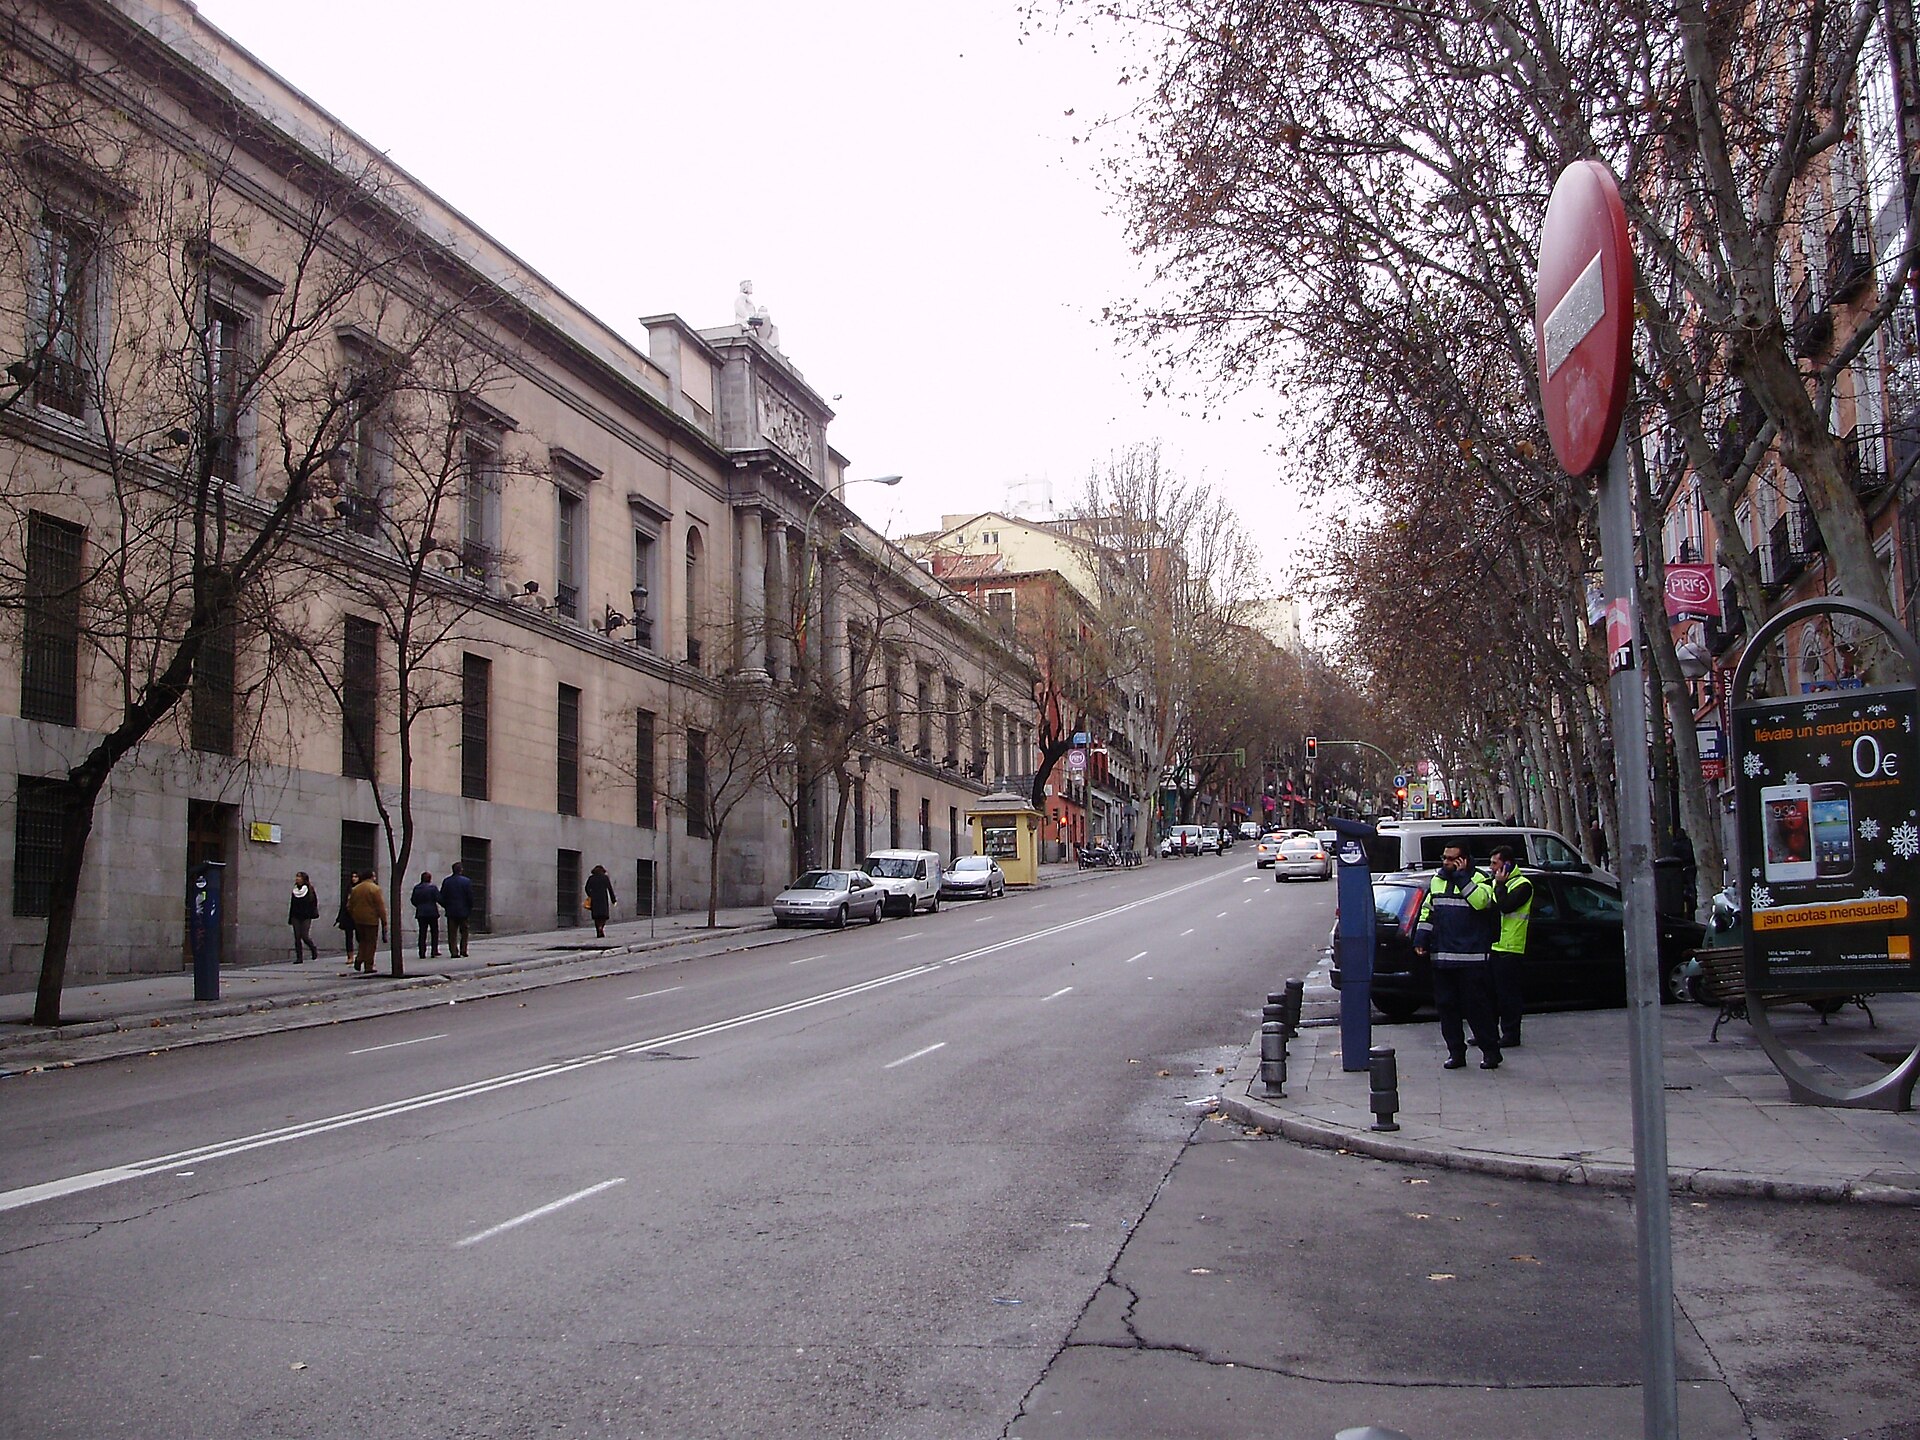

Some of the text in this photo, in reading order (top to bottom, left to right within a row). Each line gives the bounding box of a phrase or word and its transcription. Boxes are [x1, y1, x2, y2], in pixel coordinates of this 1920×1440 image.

[1802, 702, 1840, 712] JCDecaux
[1754, 717, 1897, 742] llévate un smartphone
[1763, 901, 1899, 928] ¡sin cuotas mensuales!
